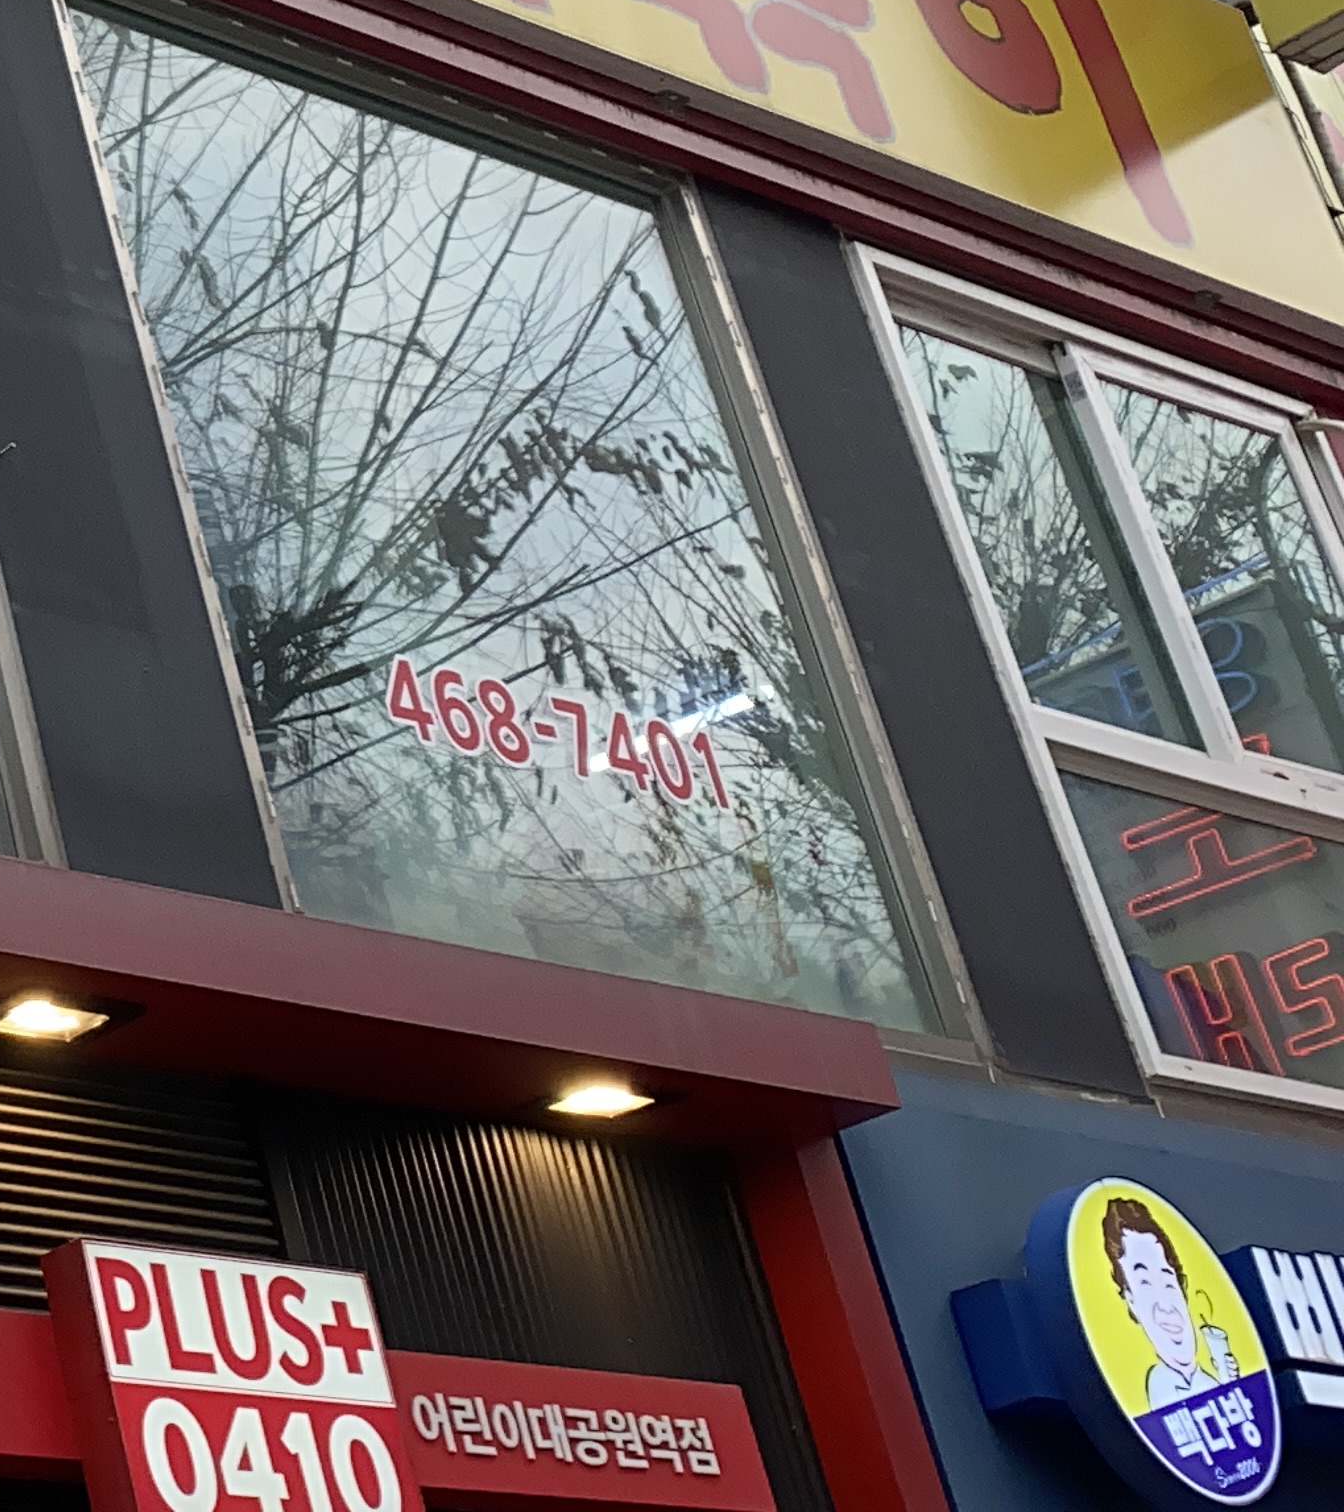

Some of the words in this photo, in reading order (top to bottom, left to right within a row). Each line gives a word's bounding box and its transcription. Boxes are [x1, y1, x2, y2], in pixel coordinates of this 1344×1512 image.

[386, 655, 730, 810] 468-7401
[94, 1255, 376, 1386] PLUS+
[140, 1395, 404, 1512] 0410
[411, 1391, 722, 1477] 어린이대공원역점
[1162, 1386, 1263, 1467] 빽다방
